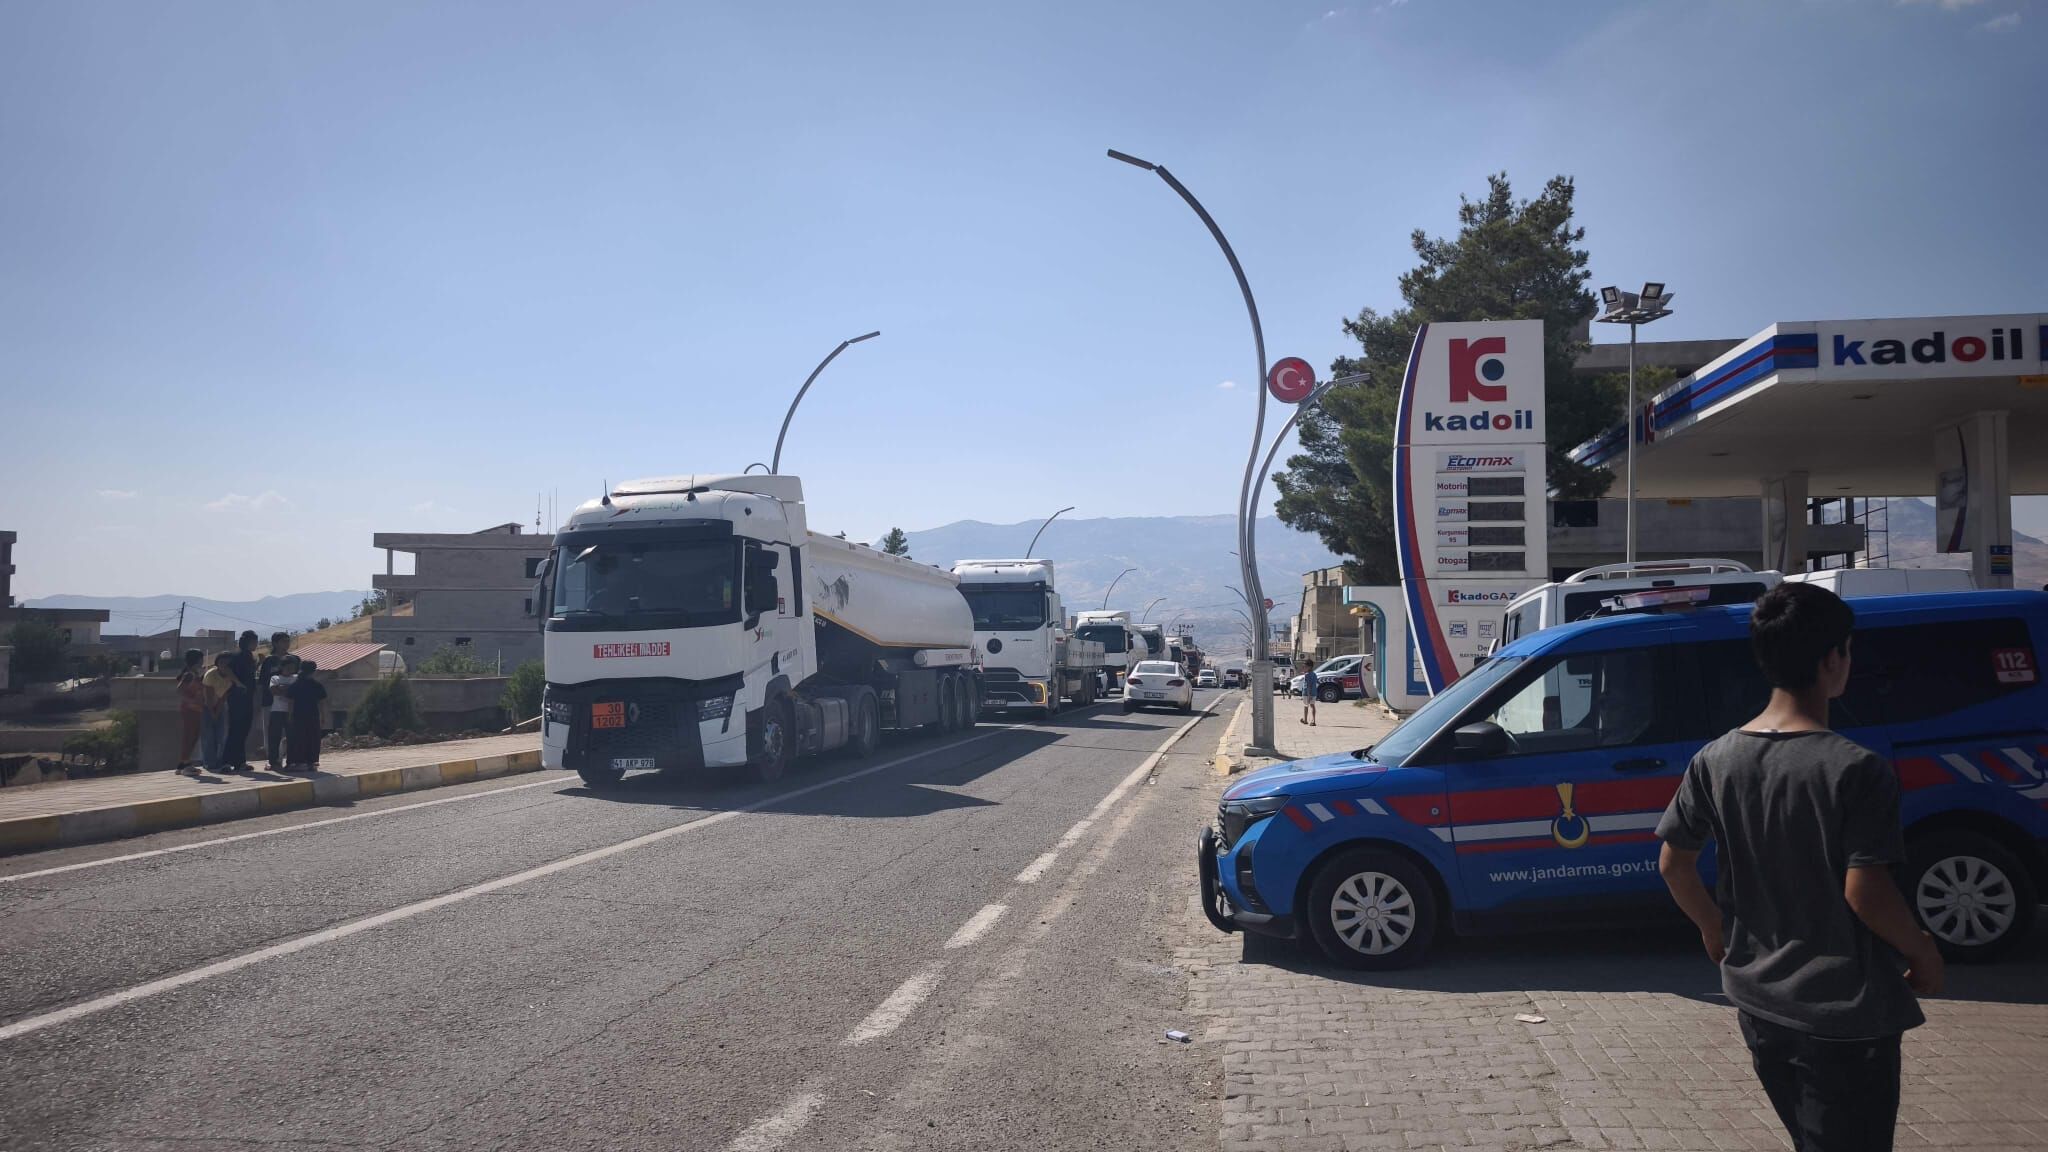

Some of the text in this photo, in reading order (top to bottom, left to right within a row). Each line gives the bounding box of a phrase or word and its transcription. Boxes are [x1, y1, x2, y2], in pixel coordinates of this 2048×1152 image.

[1833, 328, 2023, 366] kadoil
[1425, 410, 1533, 432] kadoil
[1438, 557, 1469, 566] Otogaz
[1460, 592, 1518, 602] kadoGAZ
[640, 641, 668, 657] MADDE
[1998, 652, 2028, 670] 112
[607, 703, 621, 714] 30
[596, 716, 621, 728] 1202
[614, 758, 624, 768] 41
[626, 758, 639, 768] AKP
[1490, 860, 1657, 883] www.jandarma.gov.tr
